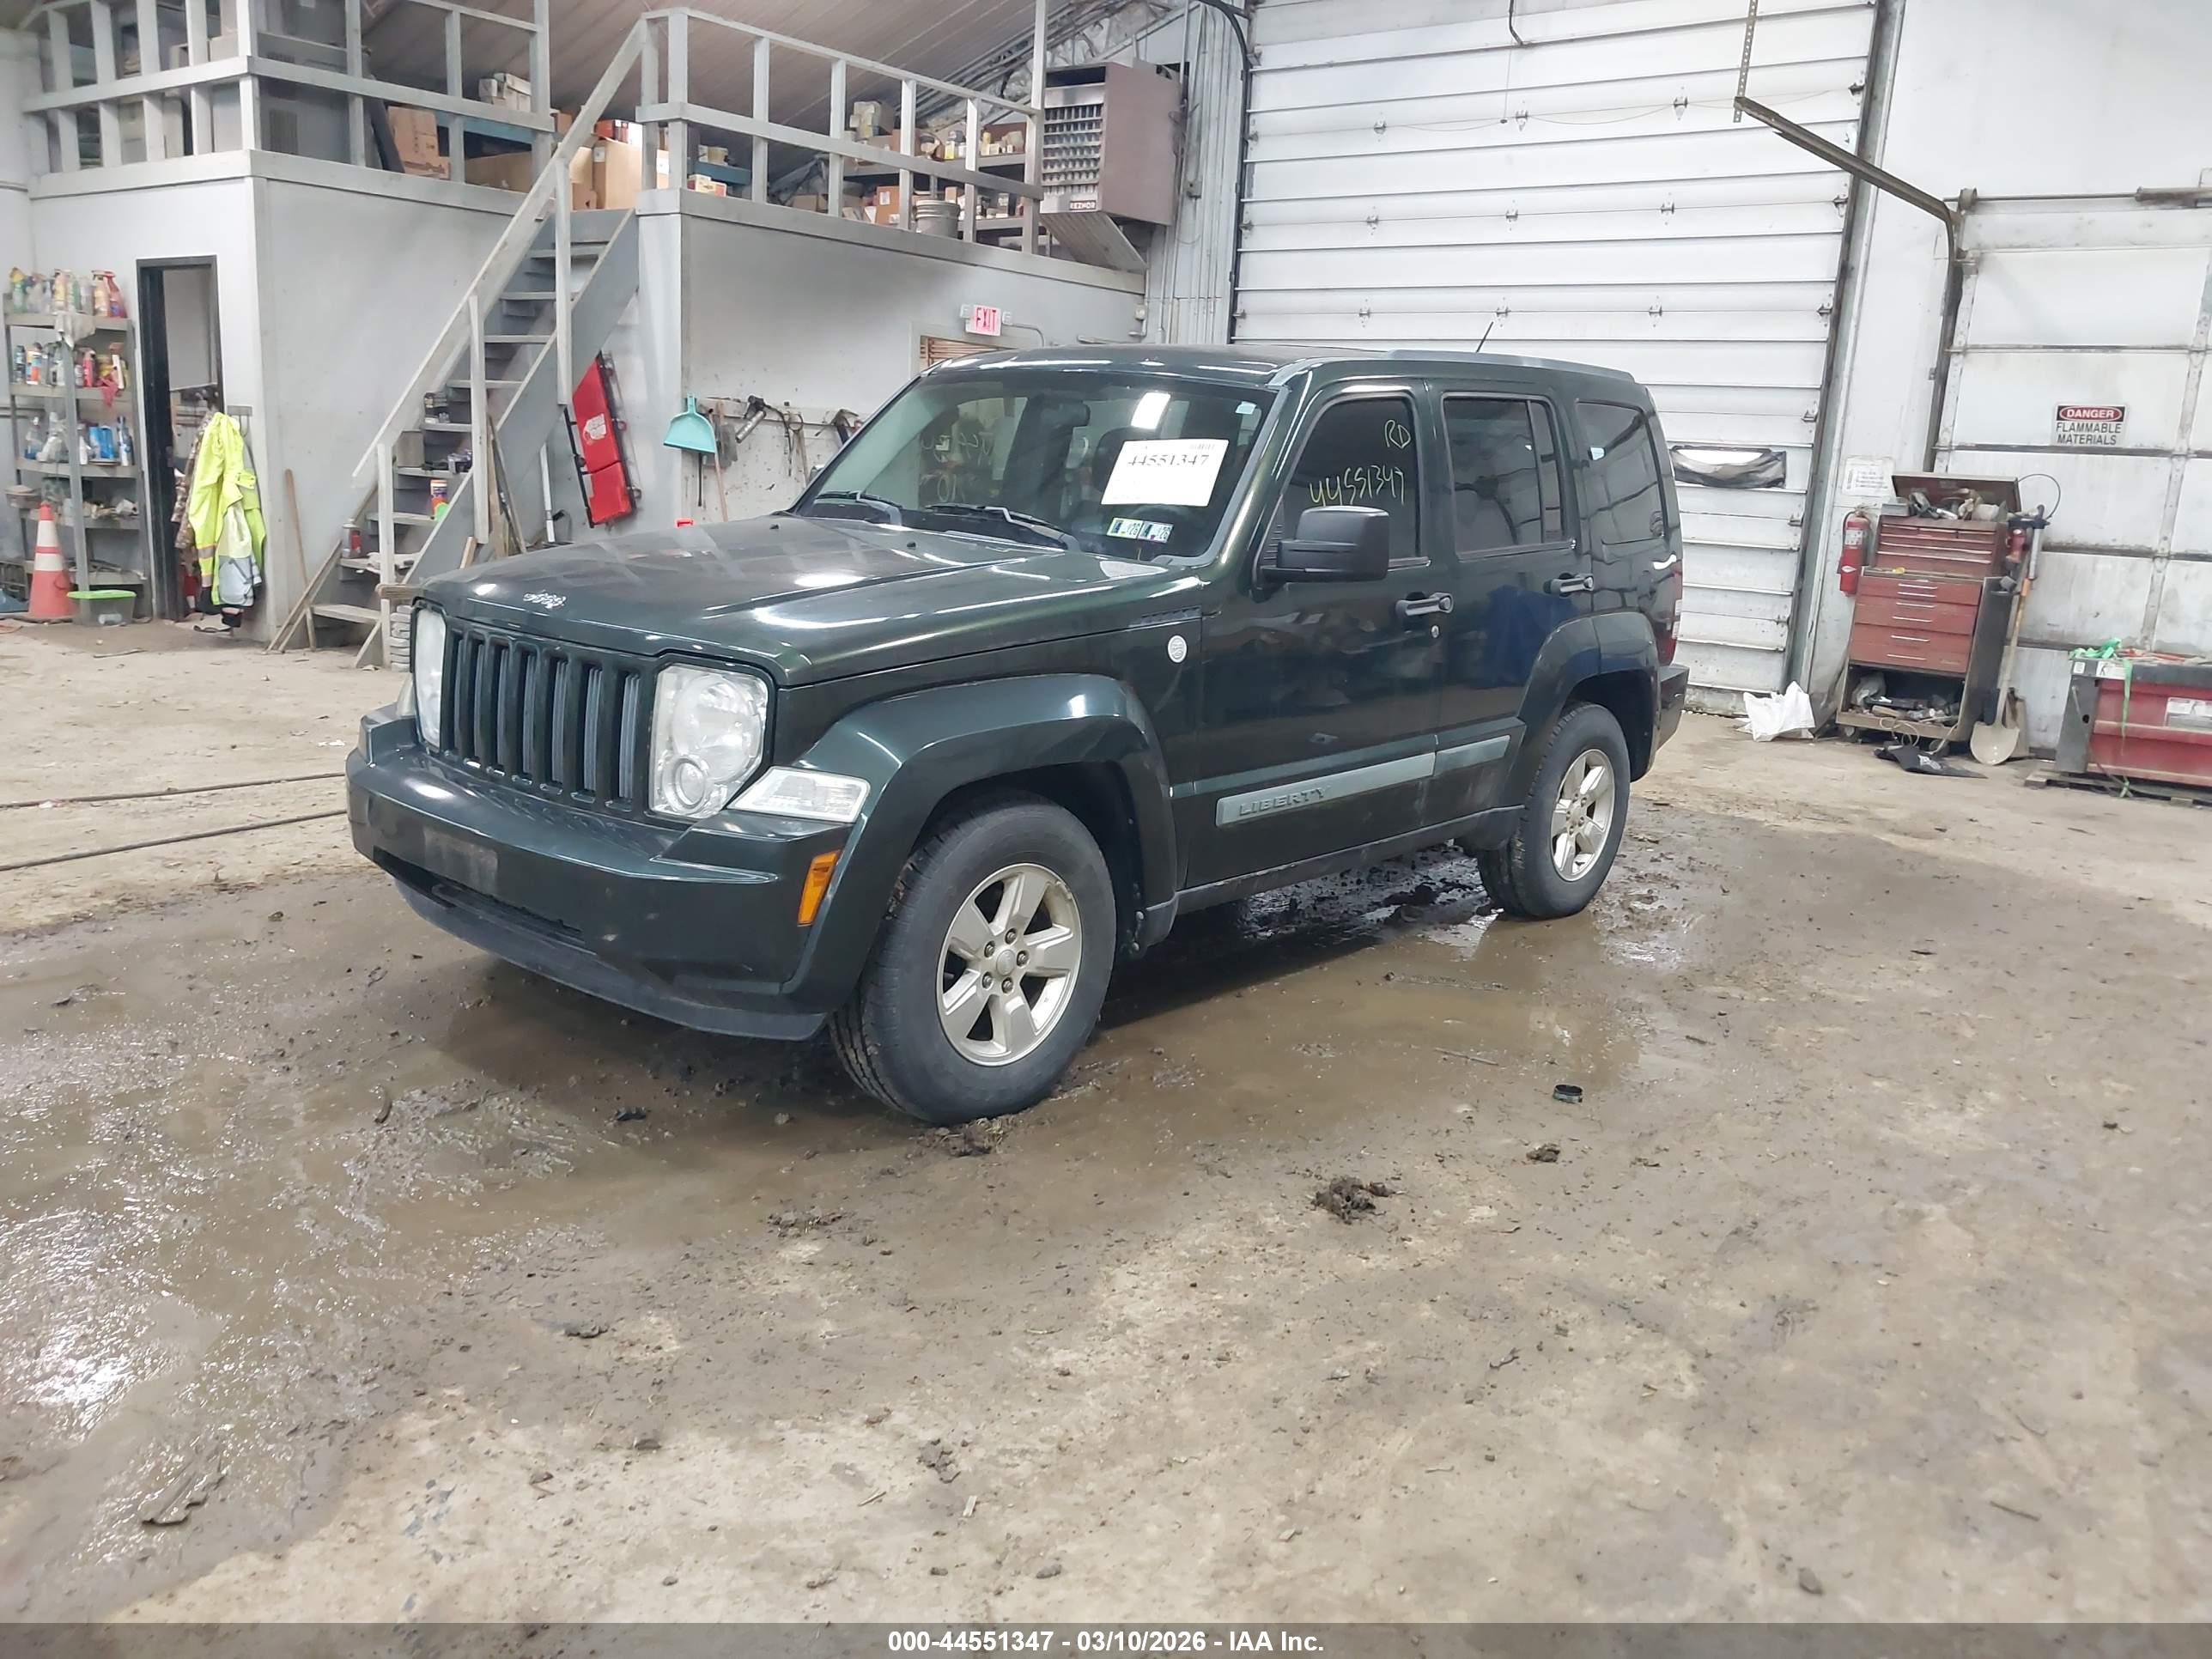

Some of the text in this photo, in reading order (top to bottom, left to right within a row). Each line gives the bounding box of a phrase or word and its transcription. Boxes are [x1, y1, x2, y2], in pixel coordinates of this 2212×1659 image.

[975, 307, 997, 331] EXIT
[2066, 408, 2114, 419] DANGER
[2056, 422, 2123, 434] FLAMMABLE
[2057, 434, 2118, 446] MATERIALS
[1127, 453, 1210, 466] 44551347
[1309, 465, 1406, 507] 44551347
[1239, 786, 1331, 816] LIBERTY
